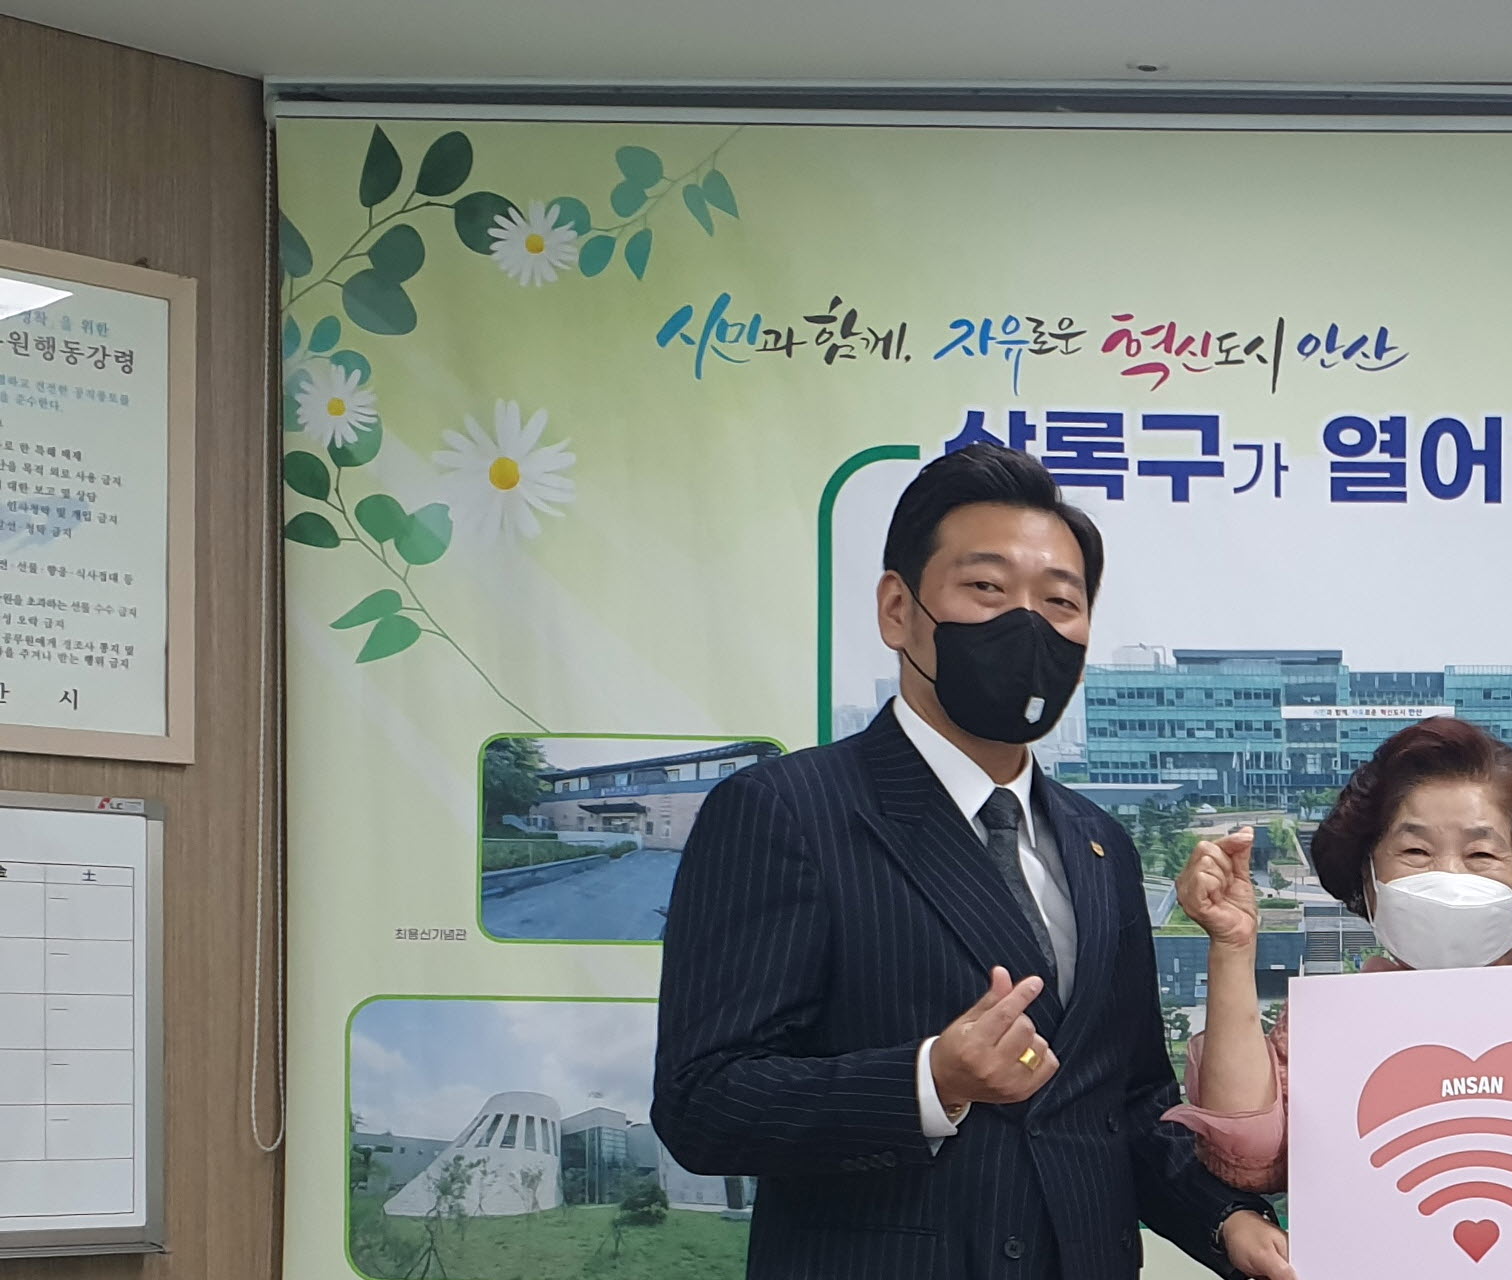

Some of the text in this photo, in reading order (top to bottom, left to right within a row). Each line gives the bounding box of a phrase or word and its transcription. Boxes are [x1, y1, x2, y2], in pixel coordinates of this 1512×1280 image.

[81, 319, 109, 337] 위한
[656, 292, 807, 380] 시민과
[933, 315, 1088, 396] 자유로운
[1101, 313, 1286, 394] 혁신도시
[1296, 322, 1410, 371] 안산
[0, 330, 135, 375] 원행동강령
[101, 474, 122, 487] 금지
[97, 512, 118, 525] 금지
[118, 606, 137, 618] 금지
[44, 617, 65, 630] 금지
[108, 657, 130, 669] 금지
[59, 688, 79, 711] 시
[395, 927, 467, 941] 최용신기념관
[1441, 1076, 1504, 1097] ANSAN
